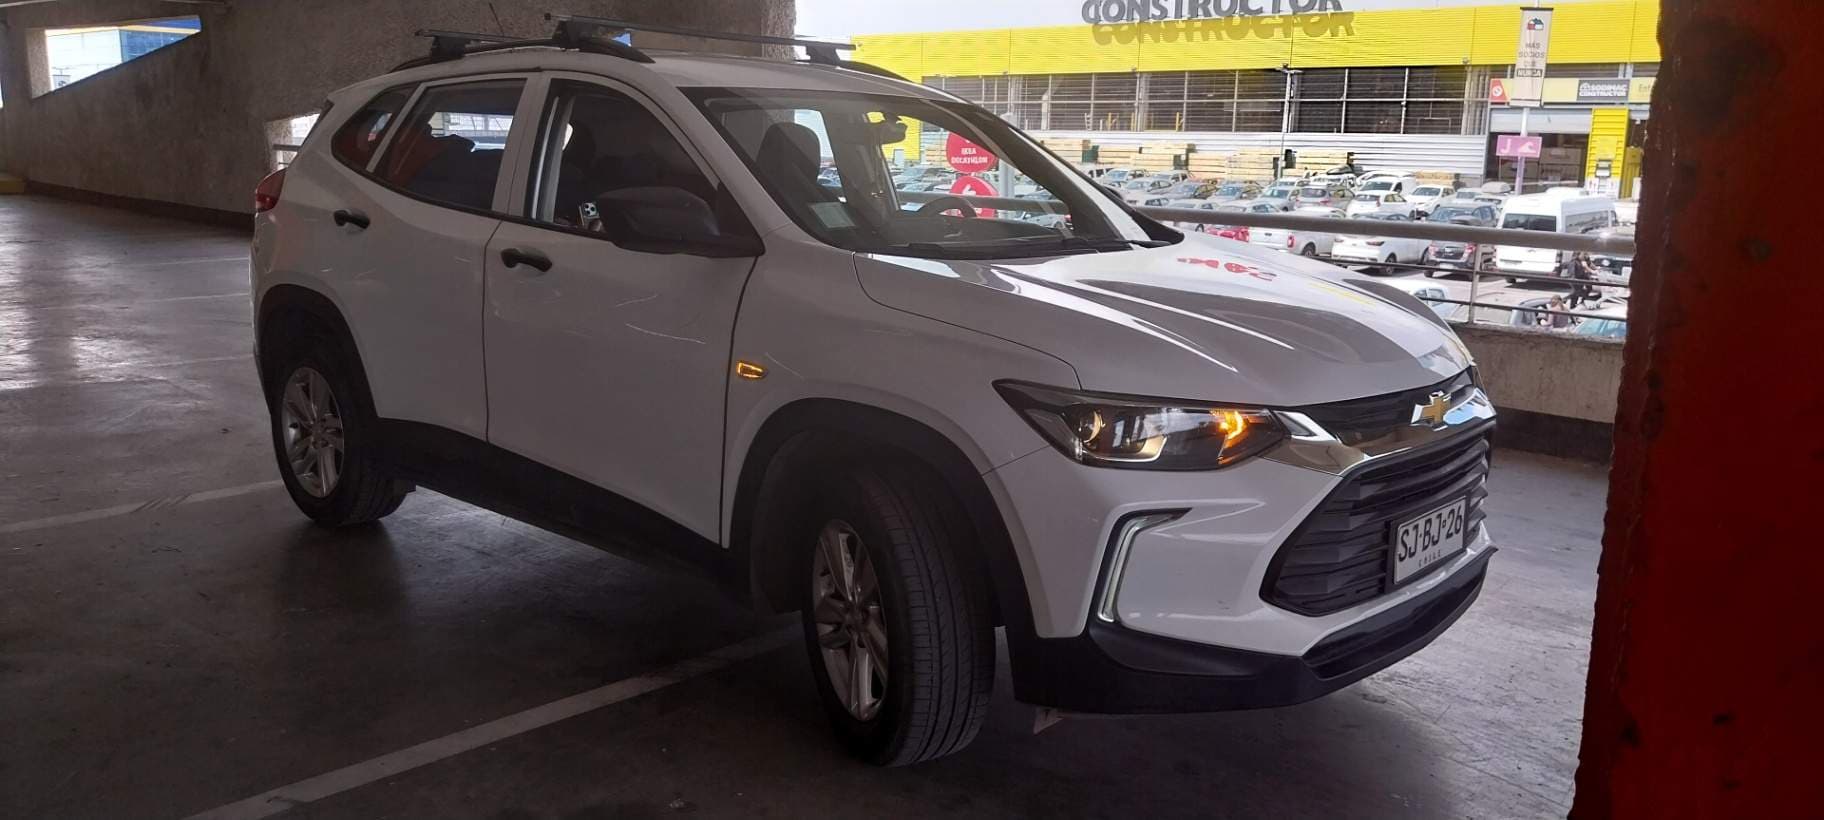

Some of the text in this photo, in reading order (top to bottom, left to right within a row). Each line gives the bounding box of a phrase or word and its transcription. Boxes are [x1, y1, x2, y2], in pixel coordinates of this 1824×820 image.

[1500, 138, 1511, 154] J
[960, 147, 977, 155] IKEA
[951, 156, 988, 164] DECATHLON
